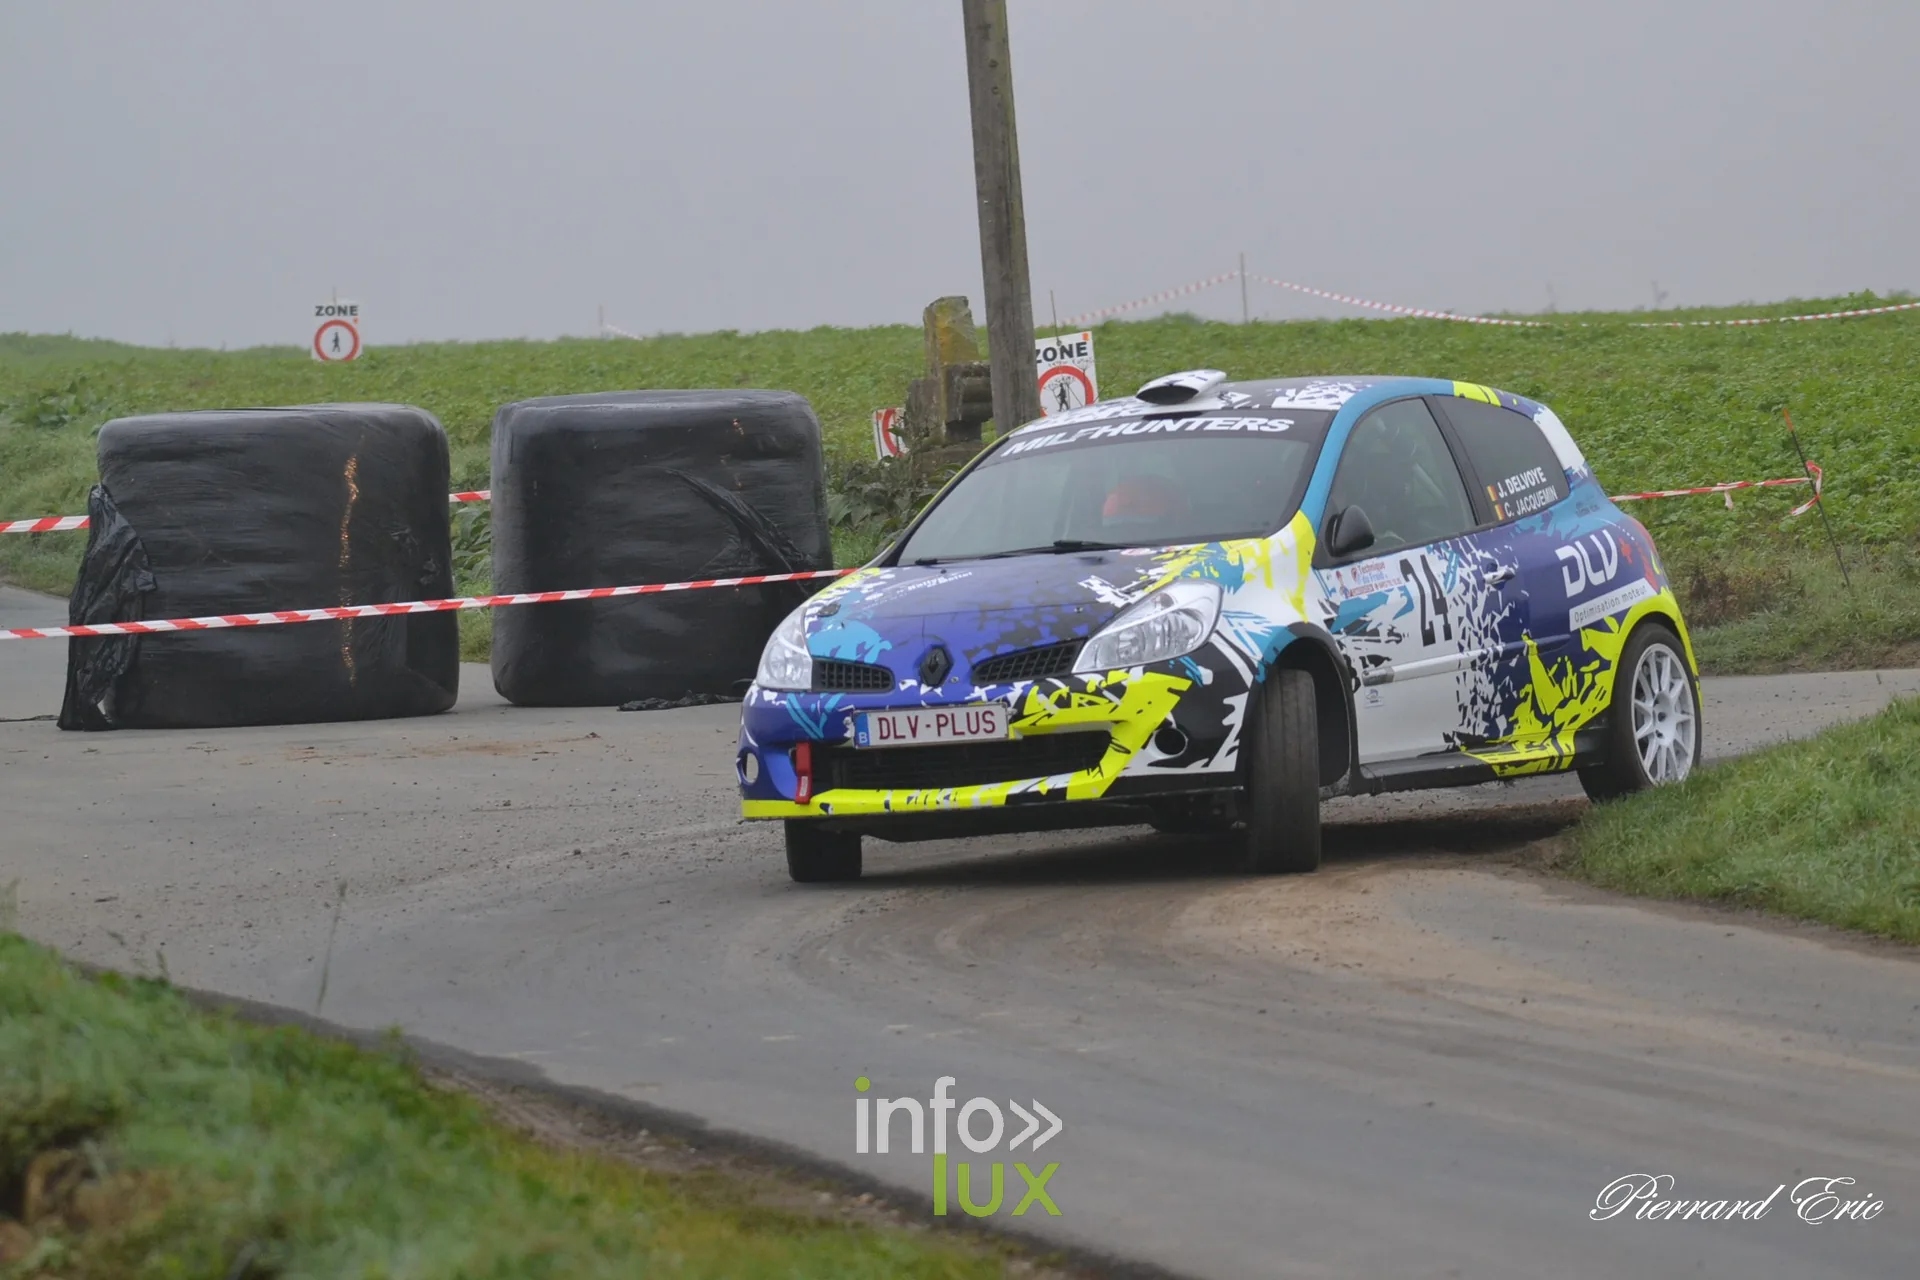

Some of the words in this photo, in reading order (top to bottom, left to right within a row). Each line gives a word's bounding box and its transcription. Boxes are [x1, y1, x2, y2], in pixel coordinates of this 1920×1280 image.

[315, 305, 358, 317] ZONE
[1001, 417, 1294, 457] MILFHUNTERS
[1497, 481, 1508, 498] J.
[1504, 466, 1547, 495] DELVOYE
[1504, 502, 1515, 518] C.
[1516, 485, 1558, 517] JACQUEMIN
[1400, 554, 1452, 647] 24
[1574, 597, 1621, 624] Optimisation
[858, 732, 868, 743] B
